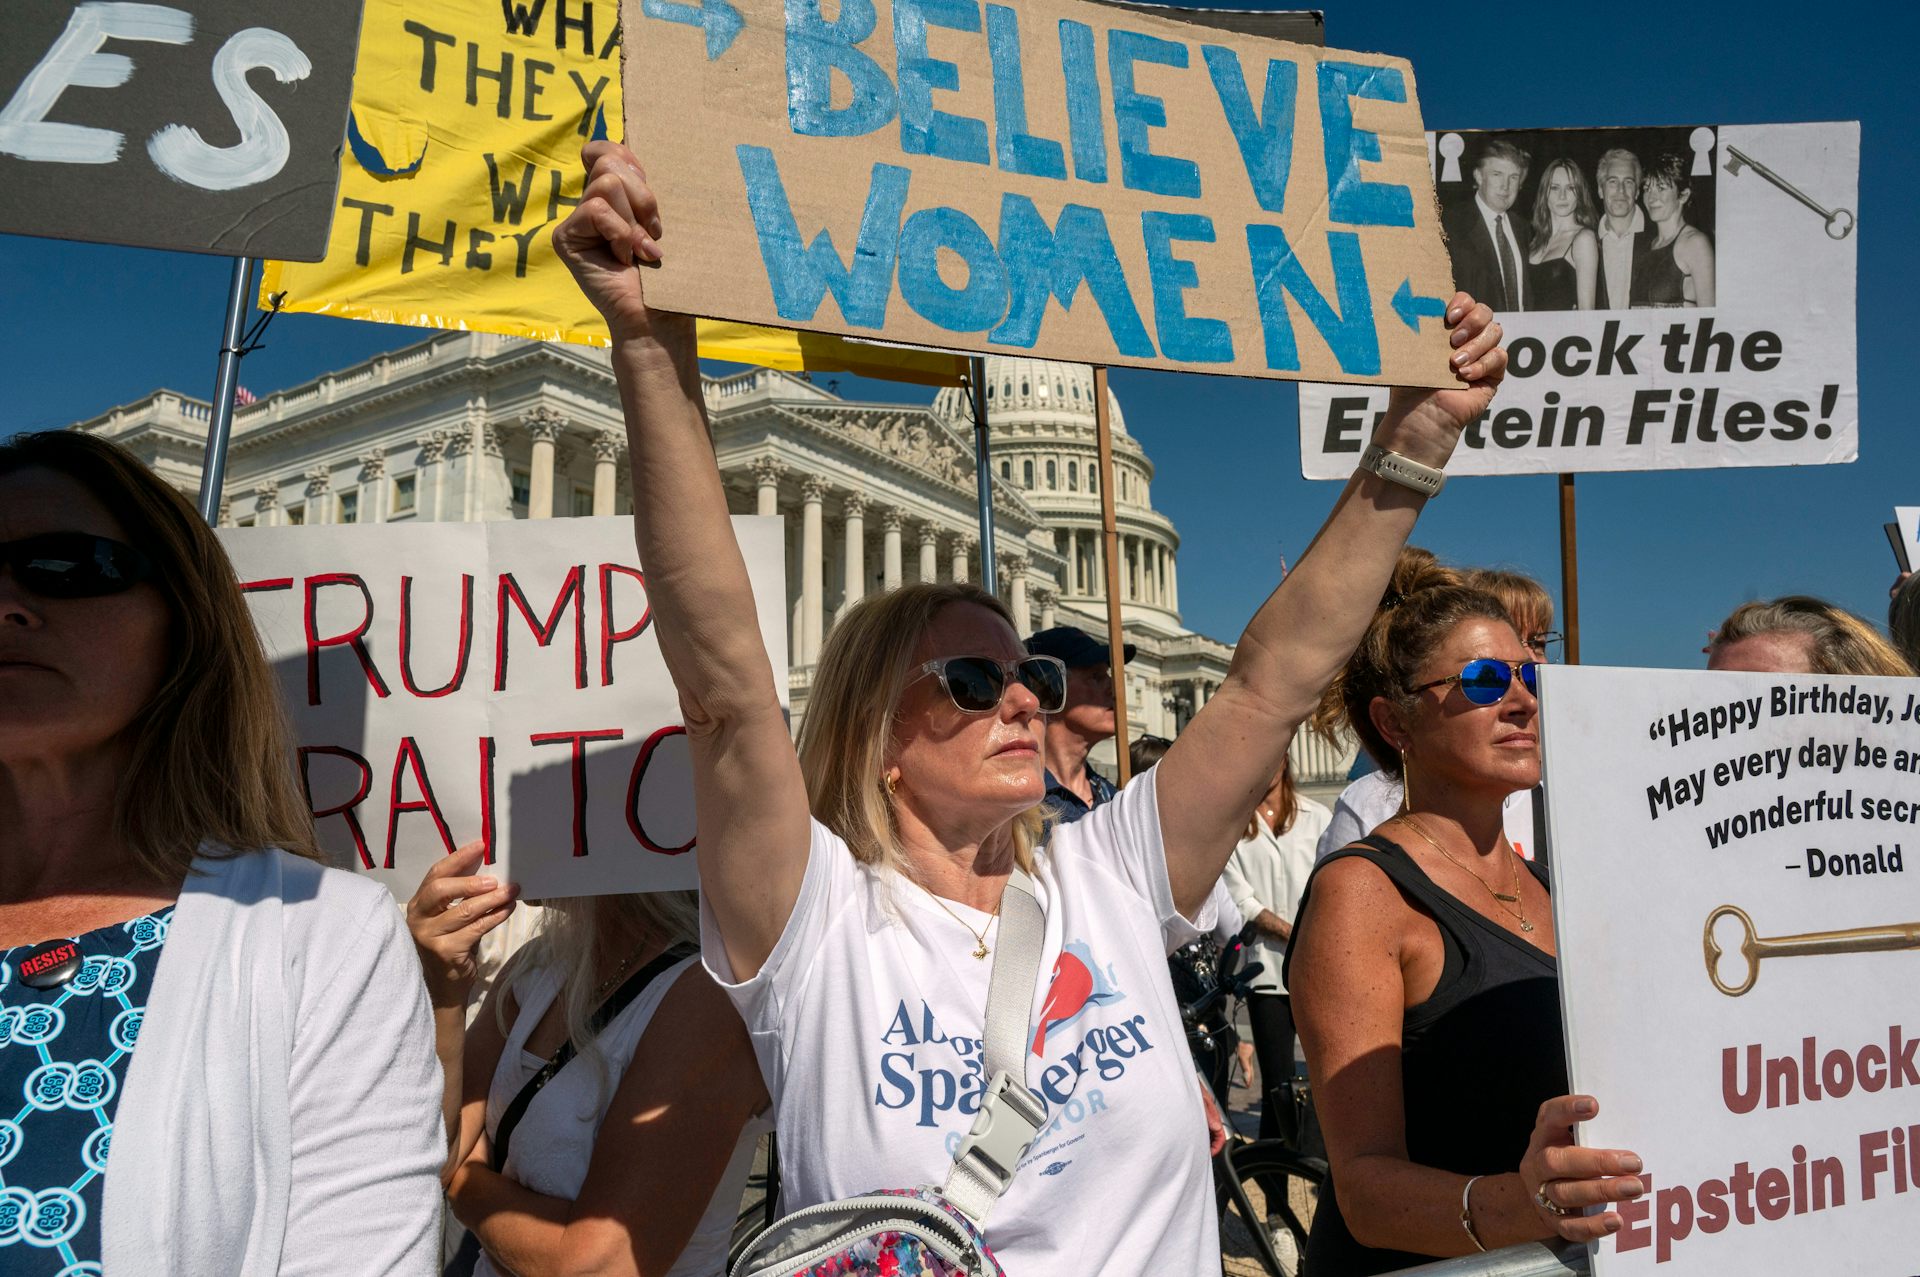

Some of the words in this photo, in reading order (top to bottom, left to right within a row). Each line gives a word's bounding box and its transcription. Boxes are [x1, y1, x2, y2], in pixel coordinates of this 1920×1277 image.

[404, 19, 610, 137] THEY
[785, 0, 1415, 229] BELIEVE
[342, 197, 548, 278] THEY
[735, 144, 1382, 377] WOMEN
[1660, 318, 1783, 374] the
[1322, 391, 1605, 453] Etein
[1626, 384, 1840, 446] Files!
[1649, 696, 1763, 748] “Happy
[1770, 684, 1894, 725] Birthday,
[1646, 768, 1706, 821] May
[1713, 747, 1791, 788] every
[1798, 737, 1848, 774] day
[1854, 737, 1887, 768] be
[1705, 789, 1853, 849] wonderful
[20, 943, 77, 977] RESIST
[1721, 1024, 1920, 1115] Unlock
[1616, 1144, 1845, 1264] Epstein
